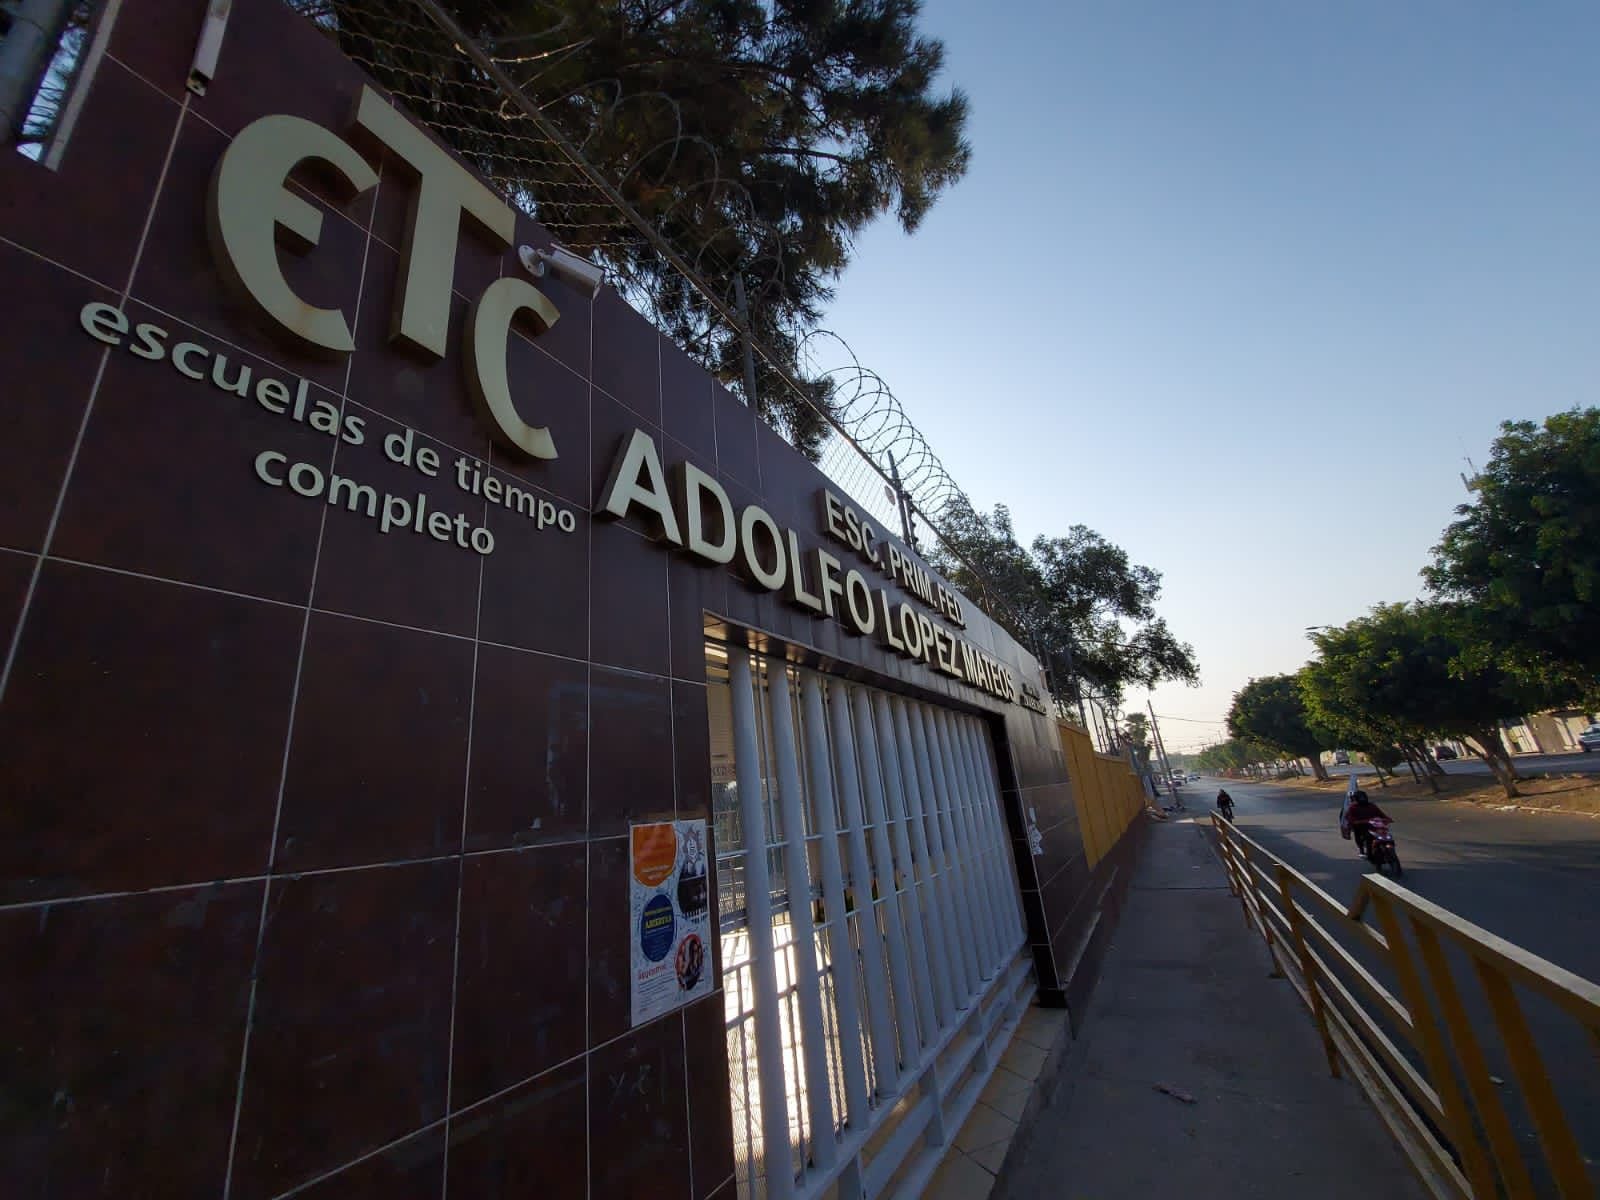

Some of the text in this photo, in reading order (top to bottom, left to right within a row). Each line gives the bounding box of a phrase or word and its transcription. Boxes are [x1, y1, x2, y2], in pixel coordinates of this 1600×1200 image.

[212, 84, 561, 461] ETC
[80, 300, 577, 534] escuelas de tiempo
[254, 450, 496, 556] completo
[603, 427, 1016, 700] ADOLFO LOPEZ MATEOS
